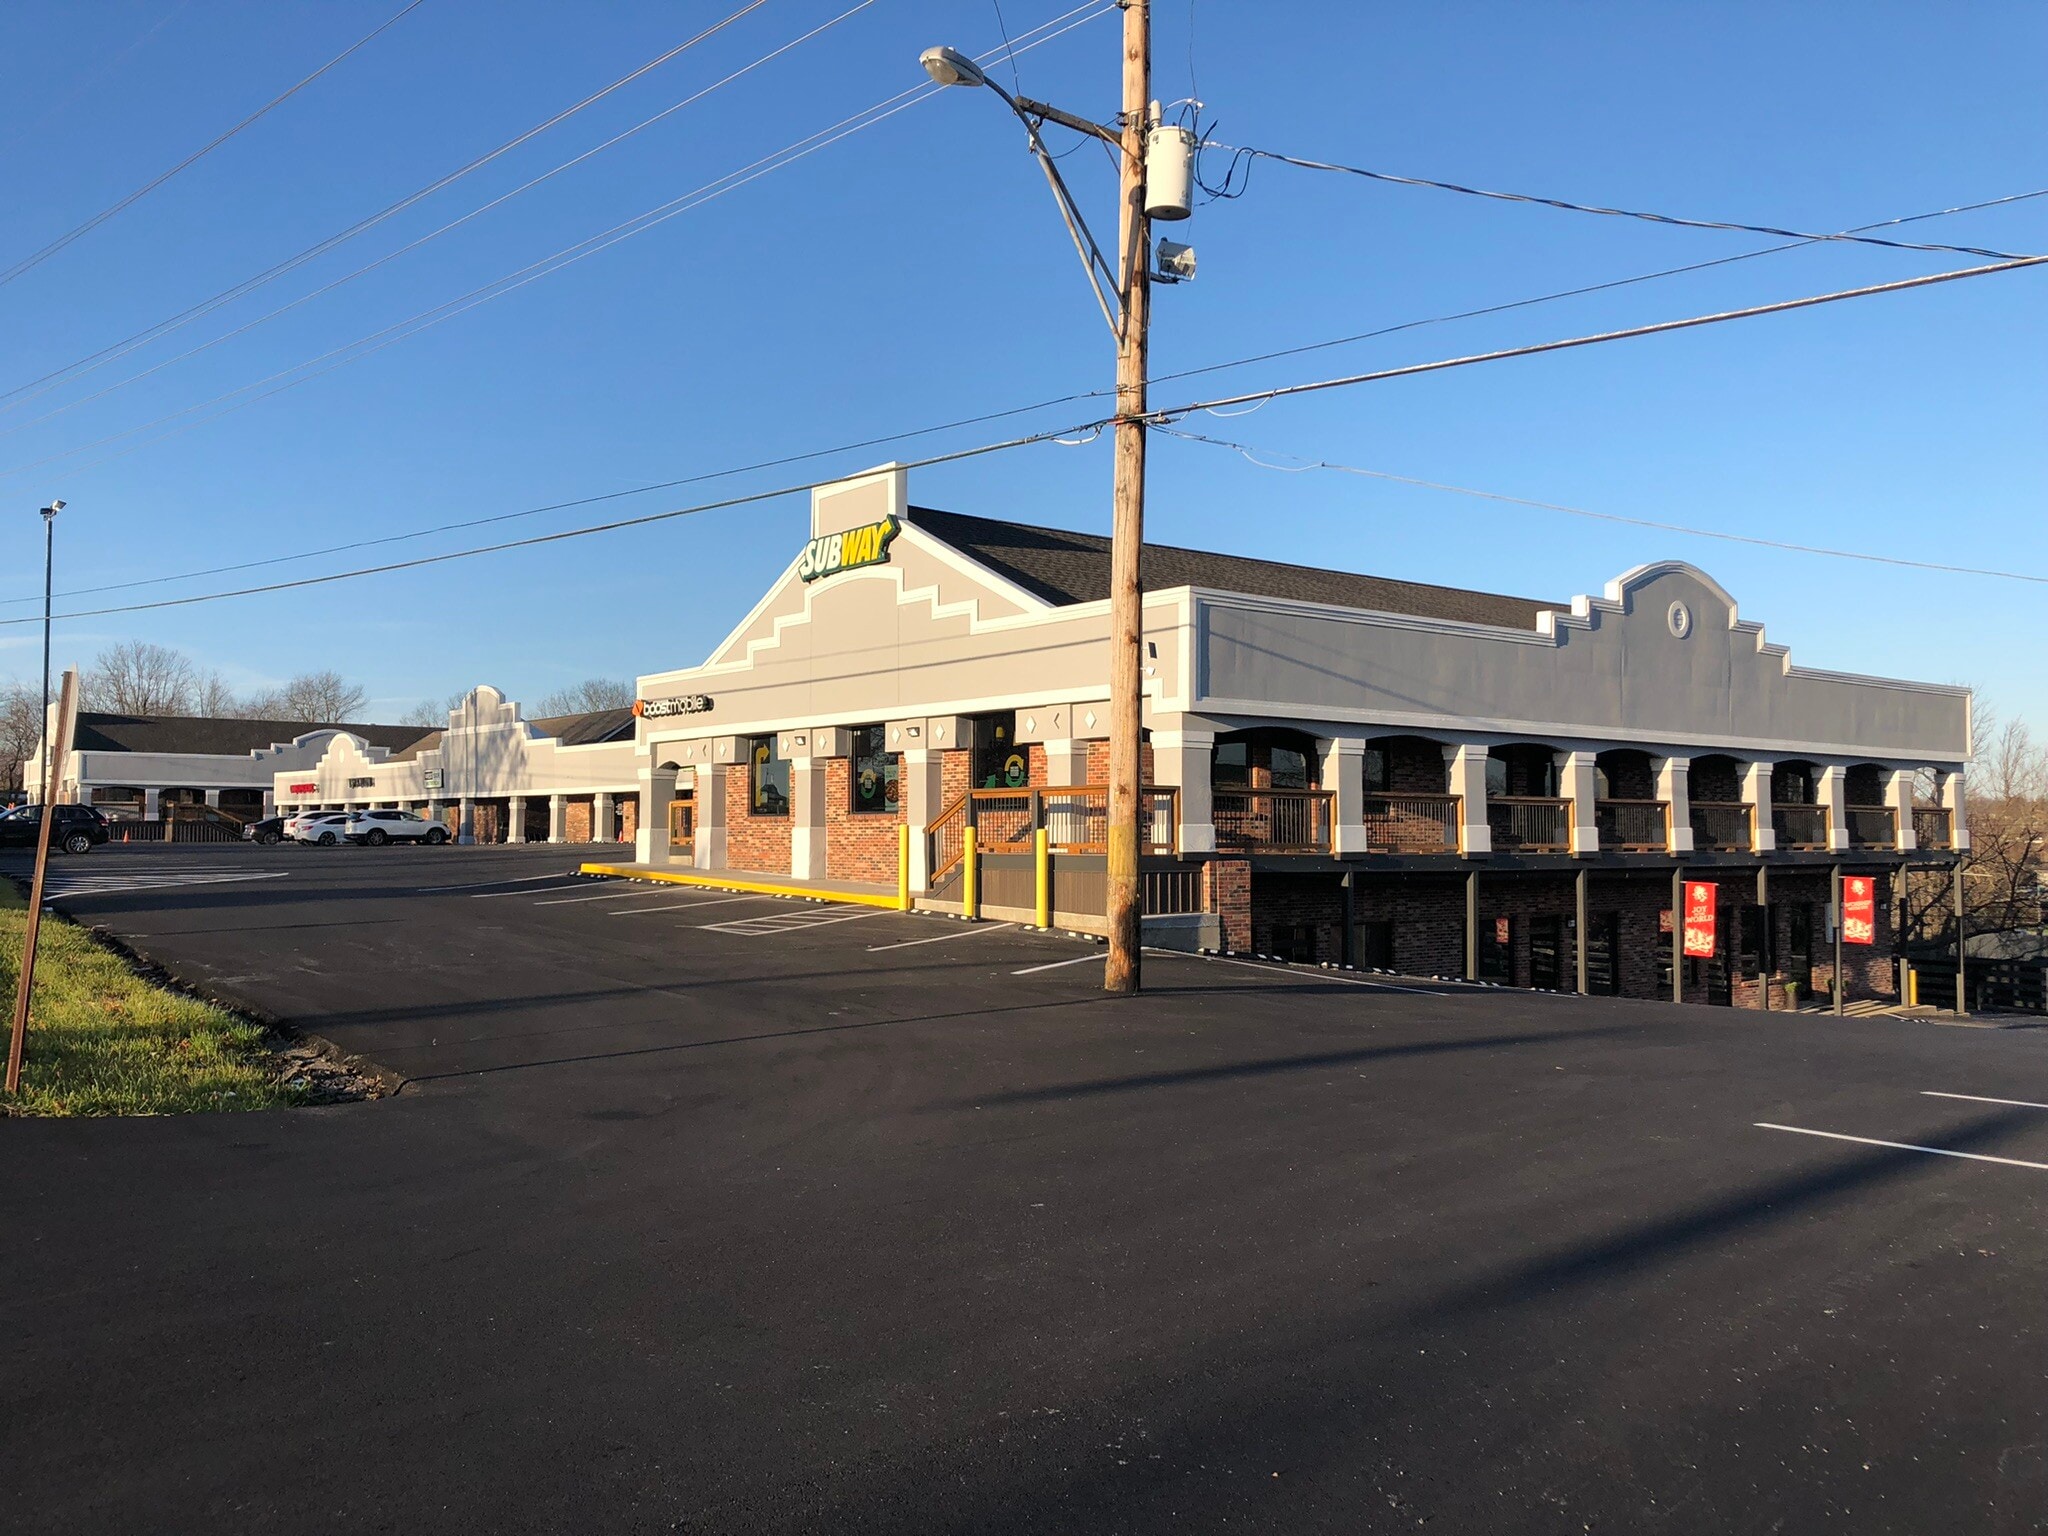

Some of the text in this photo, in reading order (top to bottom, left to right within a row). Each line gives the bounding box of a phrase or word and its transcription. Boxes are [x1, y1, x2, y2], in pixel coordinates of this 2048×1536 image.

[798, 517, 893, 577] SUBWAY
[1691, 905, 1708, 914] JOY
[1685, 914, 1714, 923] WORLD
